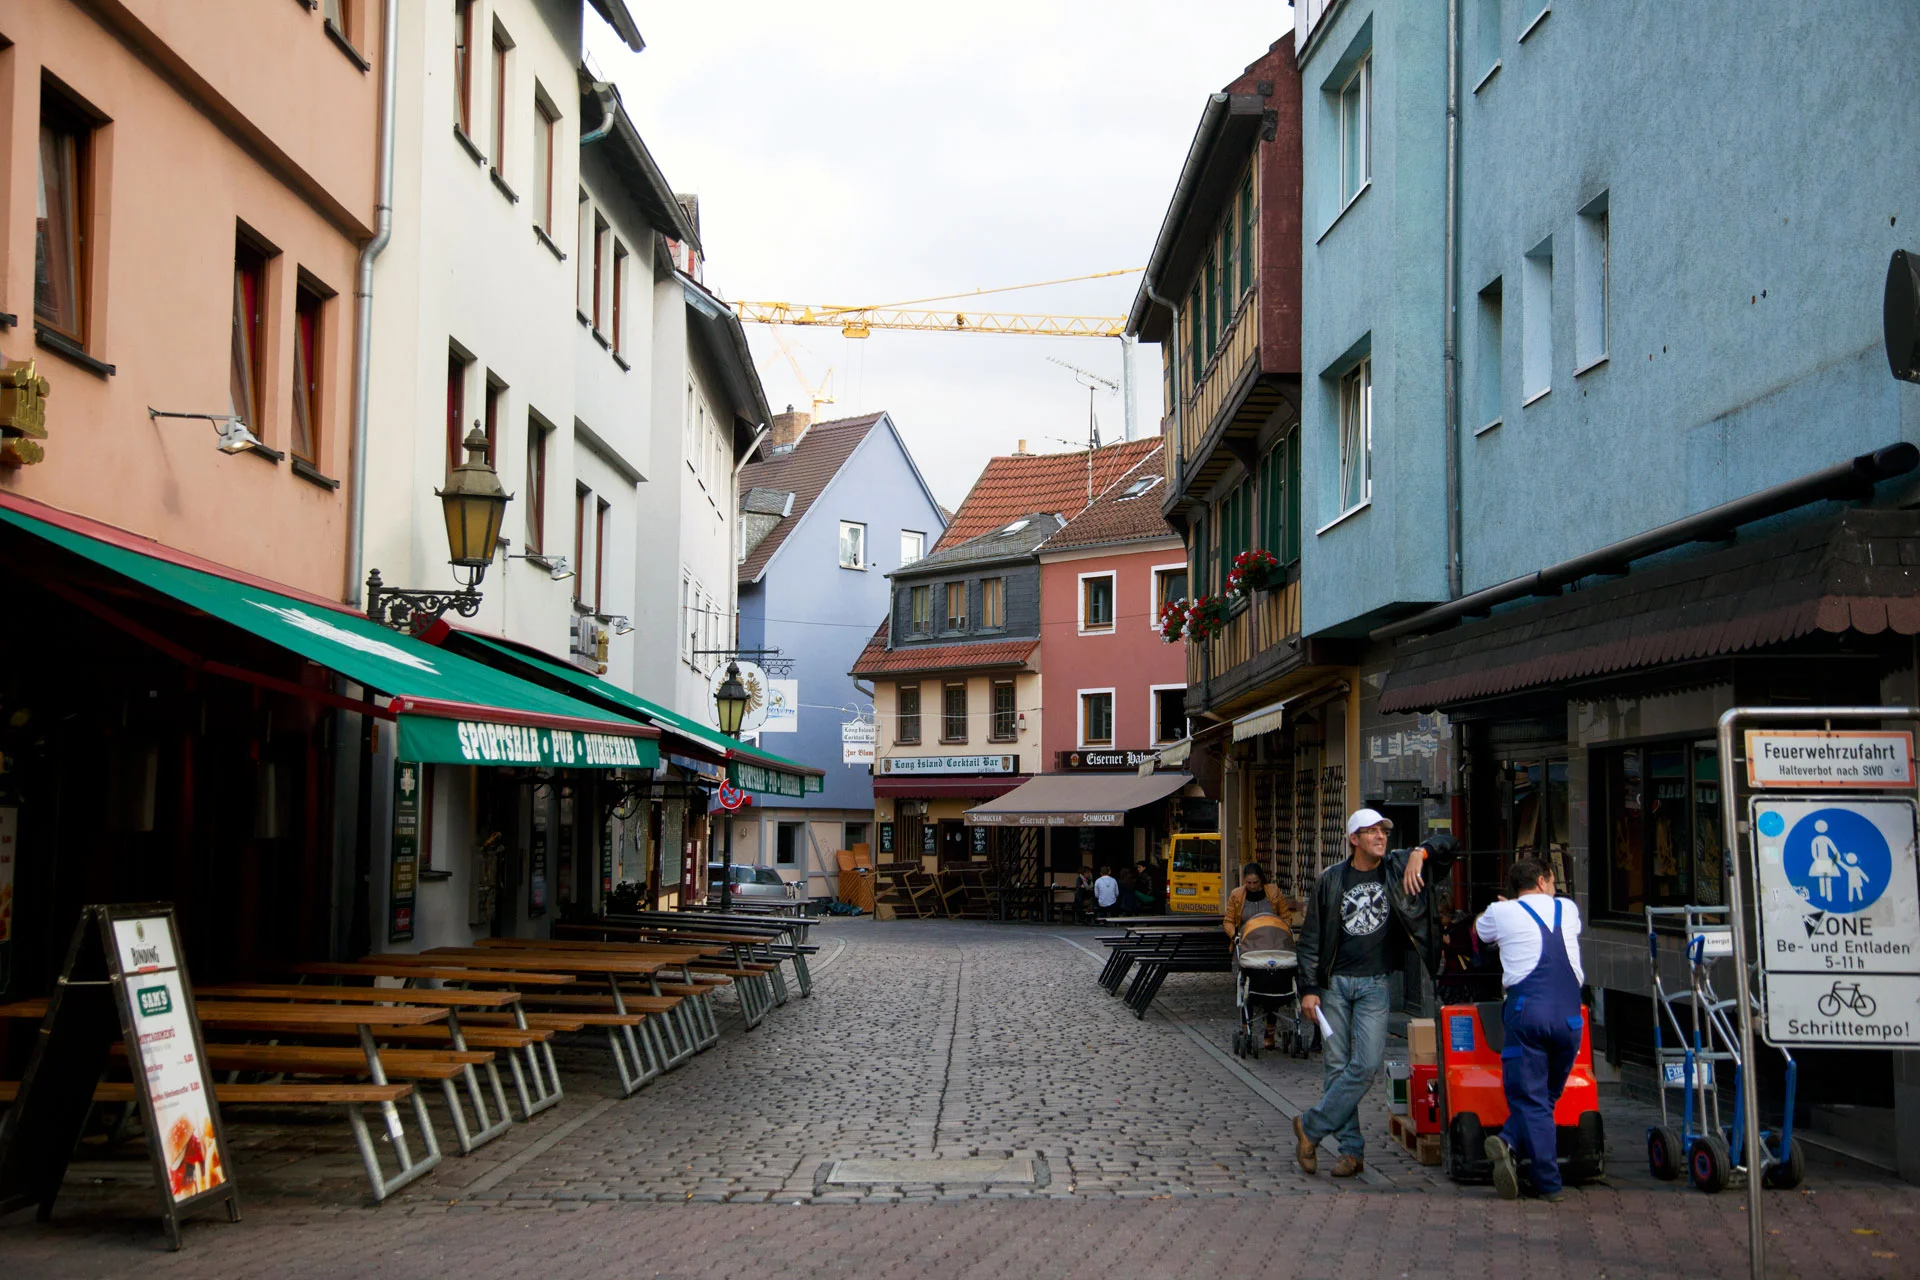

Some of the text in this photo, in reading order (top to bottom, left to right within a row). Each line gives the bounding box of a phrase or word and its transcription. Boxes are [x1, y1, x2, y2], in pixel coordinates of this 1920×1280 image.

[458, 721, 640, 766] SPORTSBAR PUB BURGERBAR
[1764, 743, 1896, 760] Feuerwehrzufahrt
[894, 756, 999, 770] Long Island Cocktail Bar
[1086, 753, 1123, 765] Eiserner
[1778, 765, 1884, 776] Halteverbot nach StVO
[972, 813, 1115, 825] SCHMUCKER Eiserner Hahn SCHMUCKER
[1776, 940, 1910, 954] Be- und Entladen
[131, 945, 160, 967] BINDING
[1825, 956, 1865, 969] 5-11 h
[141, 990, 168, 1009] SAM'S
[1788, 1020, 1910, 1040] Schritttempo!
